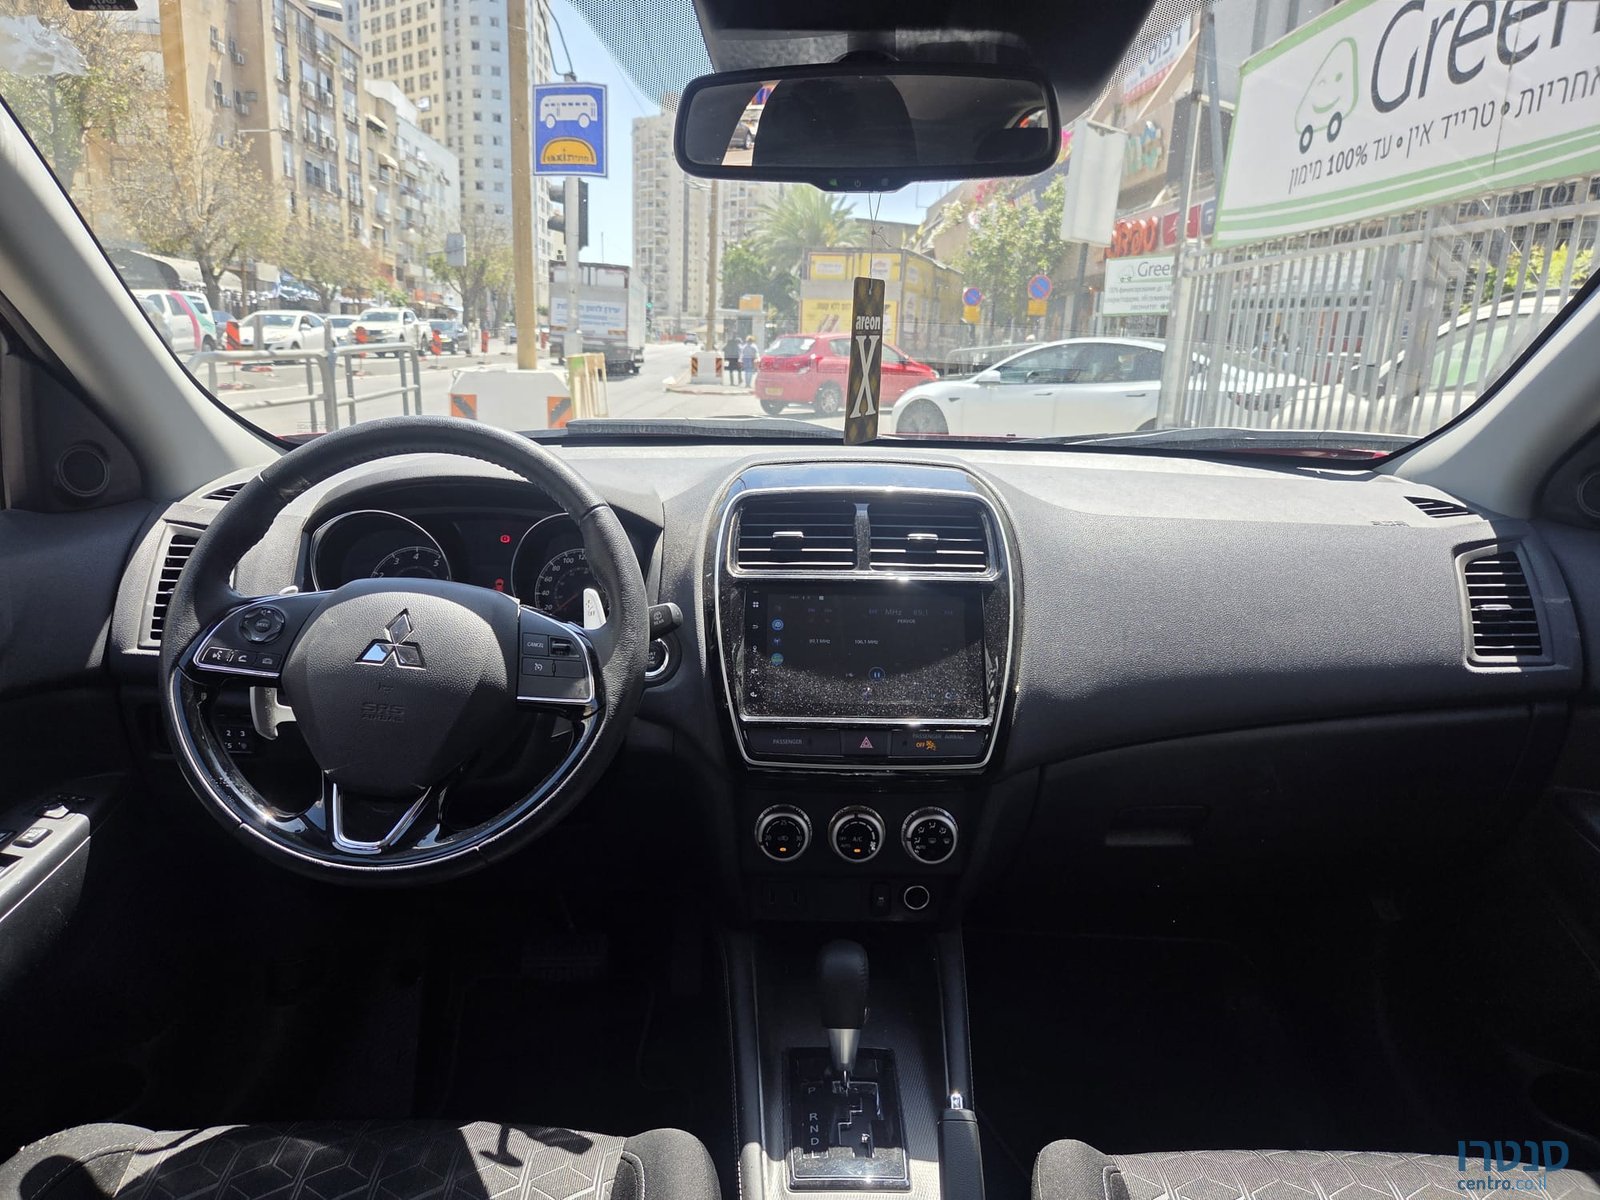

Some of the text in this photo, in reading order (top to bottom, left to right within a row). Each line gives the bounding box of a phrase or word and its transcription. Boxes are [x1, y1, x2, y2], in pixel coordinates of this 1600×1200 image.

[1440, 100, 1496, 140] טרייד
[1406, 119, 1434, 158] אין
[1372, 135, 1392, 160] עד
[1326, 145, 1368, 177] 100%
[1288, 158, 1323, 195] מימון
[1137, 261, 1174, 278] Gree
[855, 315, 881, 331] areon
[850, 335, 880, 419] X
[393, 557, 400, 565] 3
[526, 641, 544, 649] CANCEL
[808, 1086, 816, 1094] P
[809, 1112, 818, 1121] R
[810, 1125, 819, 1133] N
[810, 1137, 819, 1146] D
[811, 1150, 820, 1158] L
